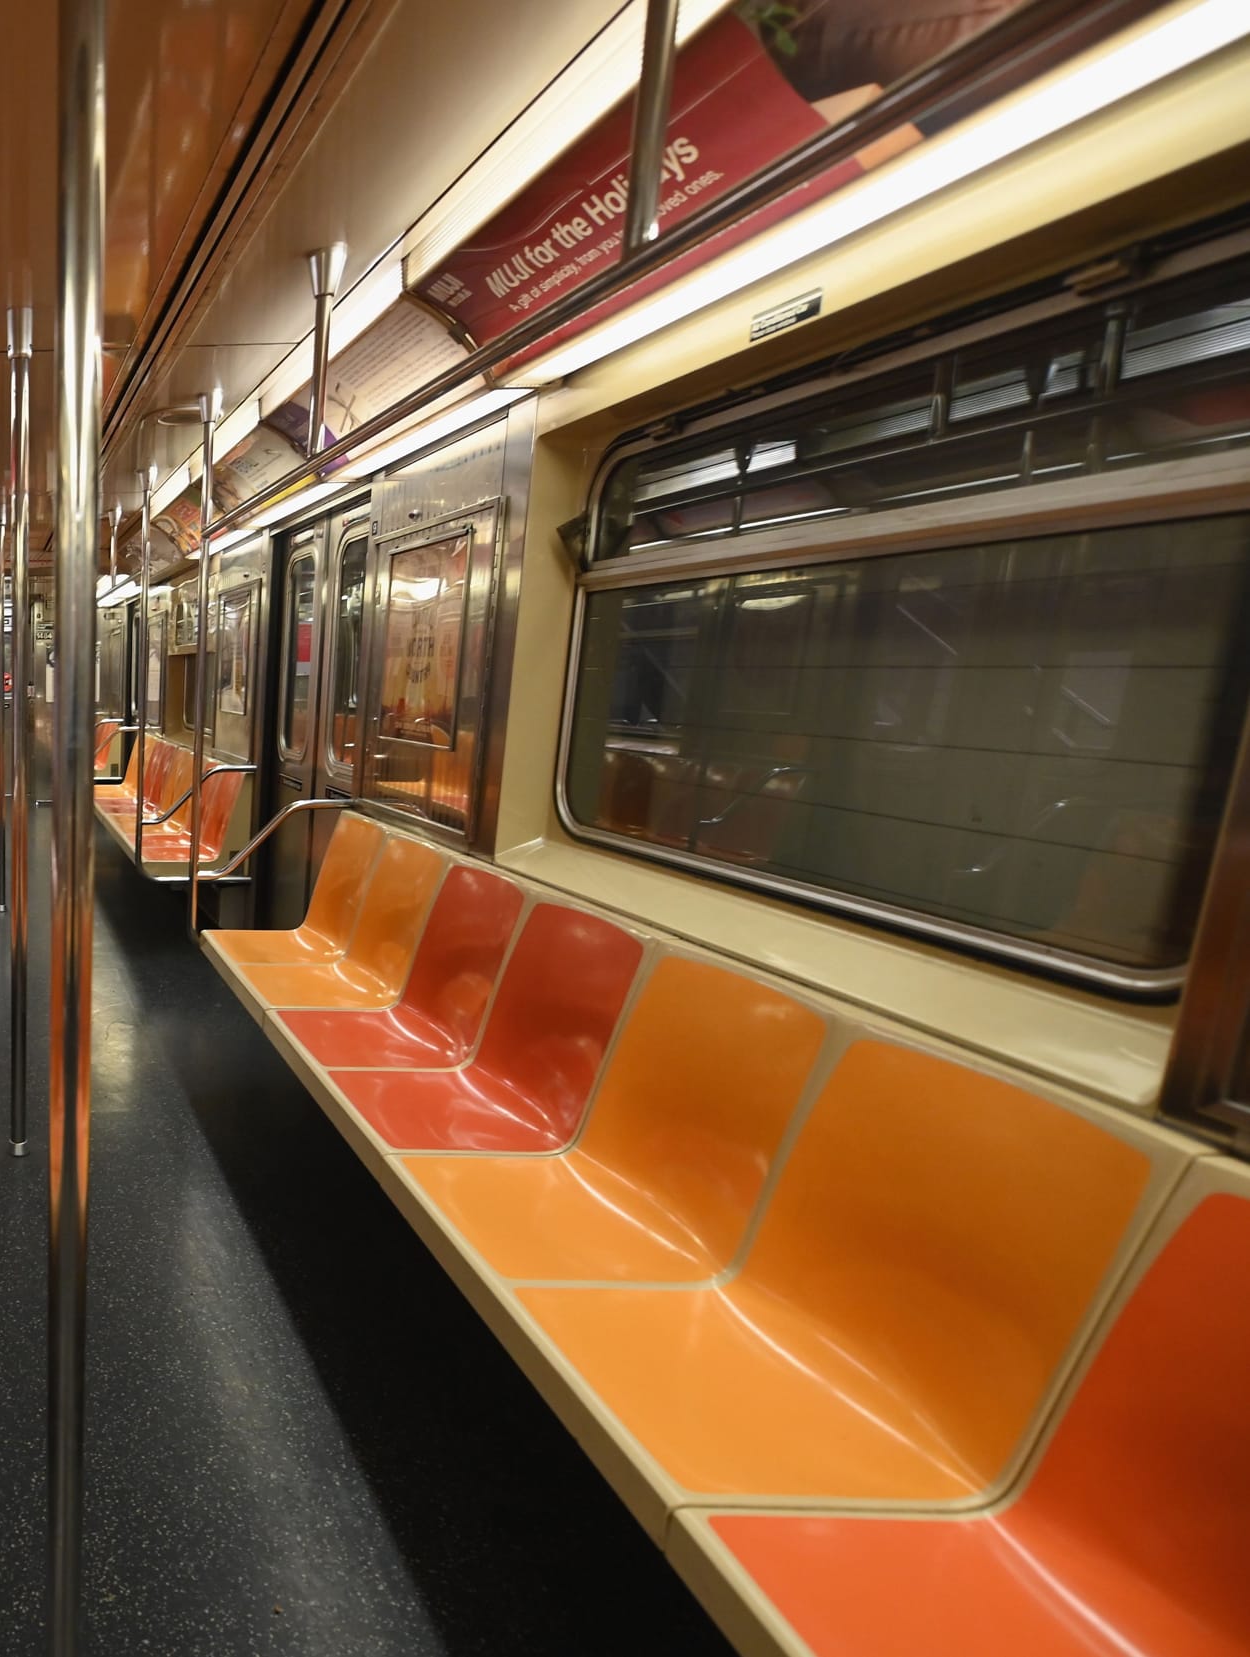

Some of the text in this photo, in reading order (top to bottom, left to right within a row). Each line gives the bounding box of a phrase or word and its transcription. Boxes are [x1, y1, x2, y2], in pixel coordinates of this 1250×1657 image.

[485, 254, 535, 298] MUJI
[524, 239, 561, 268] for
[551, 217, 593, 249] the
[581, 136, 700, 227] Holiys
[508, 303, 523, 313] A
[518, 293, 534, 310] gift
[530, 286, 542, 298] of
[539, 263, 582, 292] simplicity,
[574, 248, 603, 267] from
[598, 236, 621, 255] you
[656, 189, 688, 216] oved
[427, 272, 465, 302] MUJI
